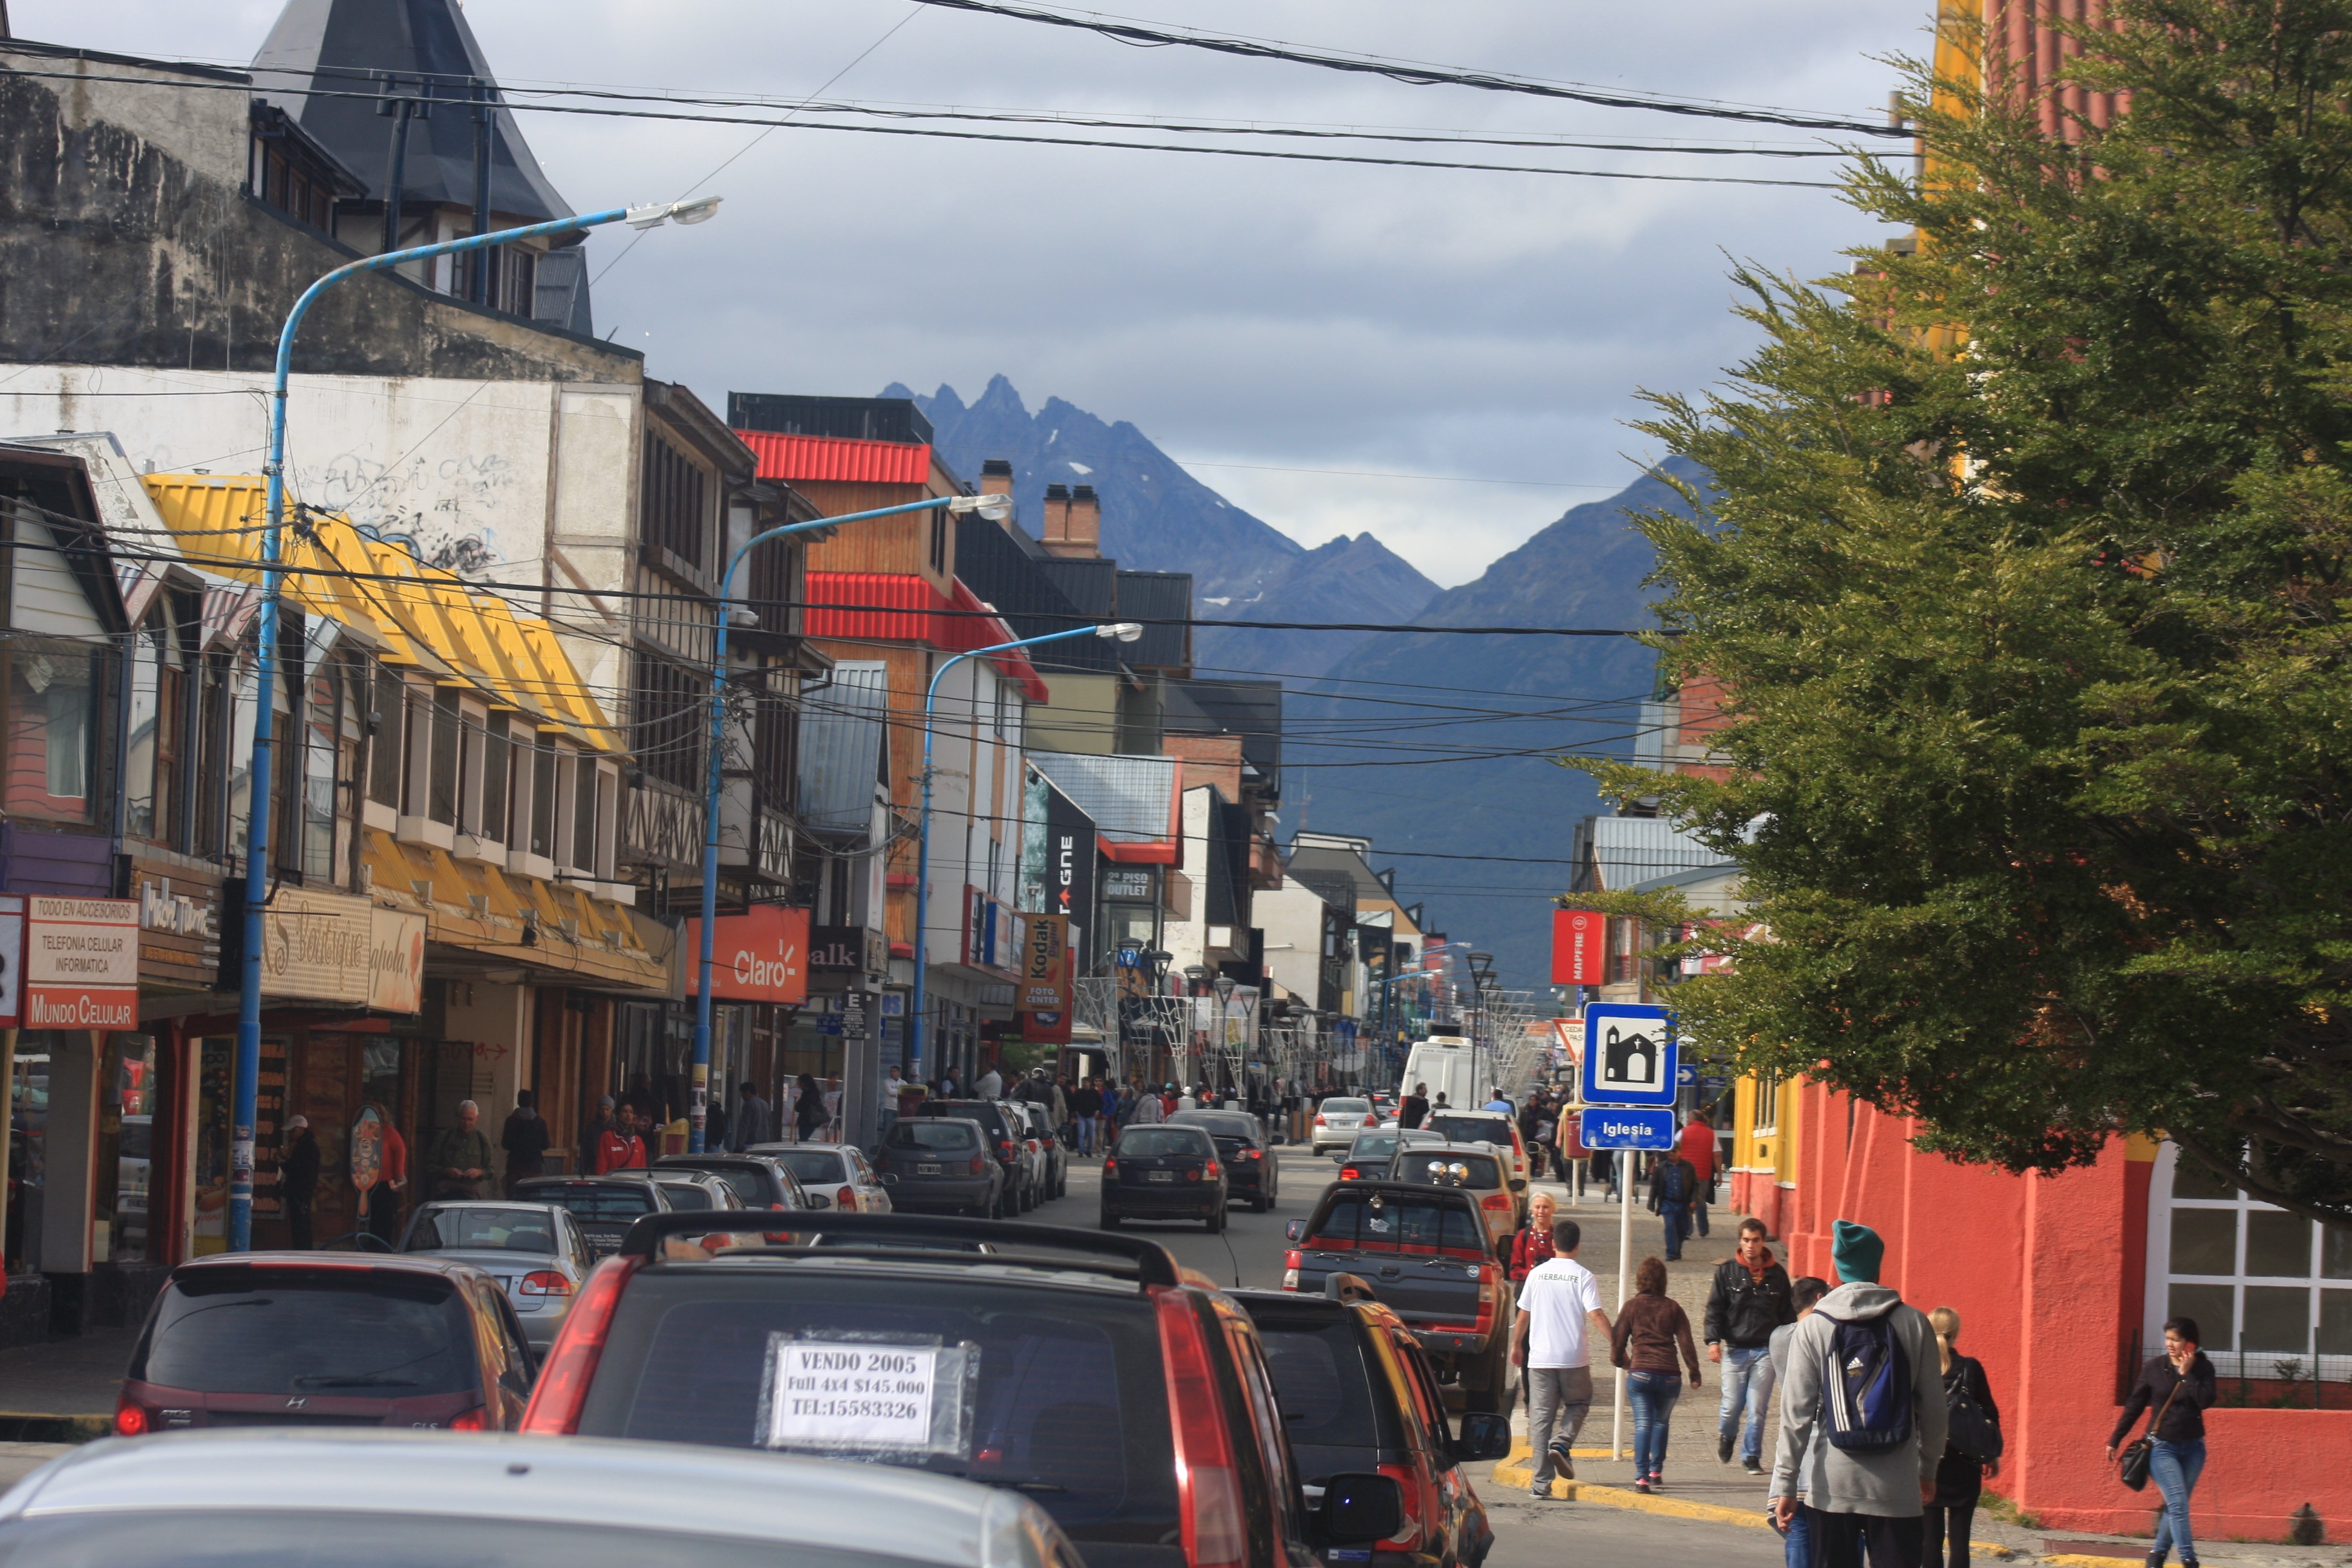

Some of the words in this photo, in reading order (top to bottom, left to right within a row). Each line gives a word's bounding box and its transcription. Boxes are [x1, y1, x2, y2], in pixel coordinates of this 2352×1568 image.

[1123, 873, 1148, 883] PISO
[1108, 884, 1147, 896] OUTLET
[39, 900, 60, 915] TODO
[63, 902, 76, 916] EN
[76, 902, 131, 919] ACCESORIOS
[42, 936, 85, 950] TELEFONIA
[87, 938, 123, 952] CELULAR
[1030, 920, 1048, 979] Kodak
[1573, 932, 1584, 979] MAPFRE
[56, 958, 109, 973] INFORMATICA
[734, 950, 785, 987] Claro
[848, 994, 860, 1007] E
[1026, 996, 1060, 1004] CENTER
[31, 994, 76, 1023] MUNDO
[79, 995, 131, 1024] CELULAR
[1603, 1122, 1653, 1137] Iglesia
[1538, 1273, 1579, 1283] HERBALIFE
[801, 1353, 861, 1370] VENDO
[868, 1354, 916, 1373] 2005
[788, 1377, 815, 1390] Full
[820, 1377, 848, 1391] 4x4
[854, 1379, 925, 1394] $145.000
[792, 1399, 917, 1419] TEL:15583326
